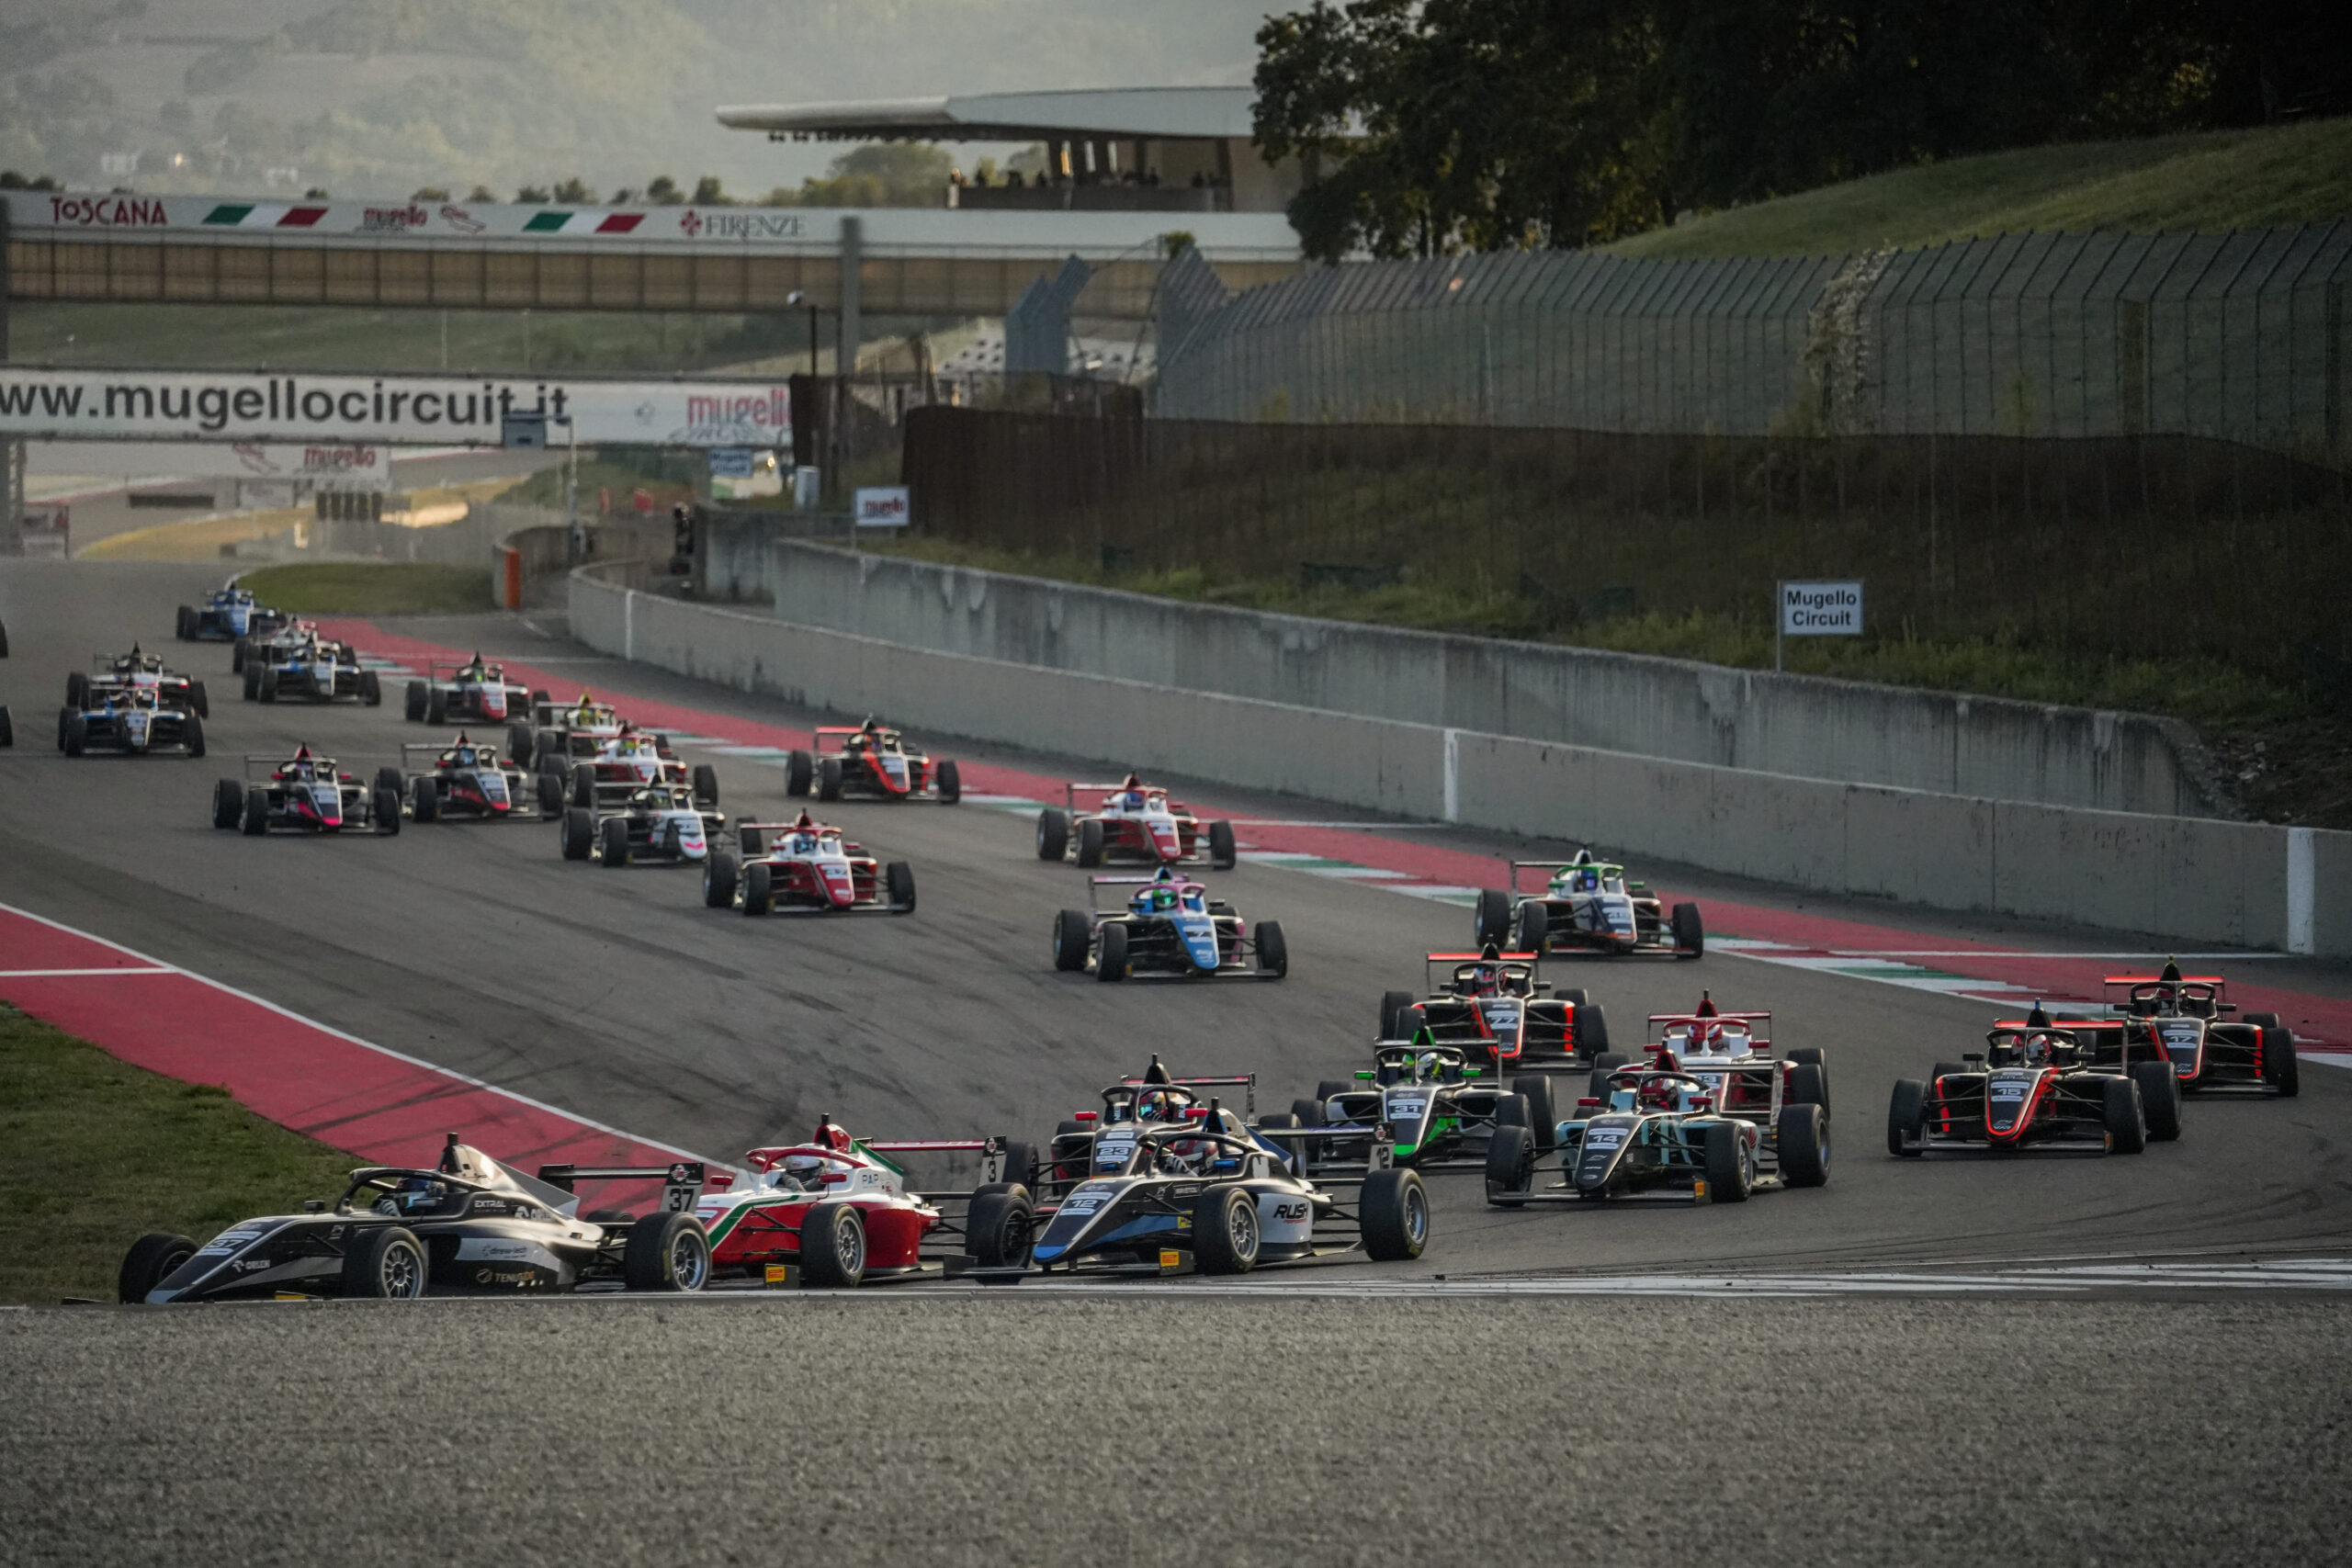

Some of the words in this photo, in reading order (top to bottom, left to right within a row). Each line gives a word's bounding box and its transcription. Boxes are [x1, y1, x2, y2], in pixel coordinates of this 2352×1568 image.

[50, 196, 167, 225] TOSCANA
[706, 213, 807, 242] FIRENZE
[0, 378, 569, 432] ww.mugellocircuitit
[687, 389, 792, 425] mugell
[1787, 590, 1857, 609] Mugello
[1792, 611, 1851, 626] Circuit
[1592, 1134, 1617, 1143] 14
[1099, 1147, 1128, 1156] 23
[988, 1160, 997, 1182] 3
[669, 1188, 695, 1212] 37
[1071, 1200, 1098, 1208] 12
[1272, 1201, 1309, 1220] RUSH
[209, 1239, 245, 1248] 37
